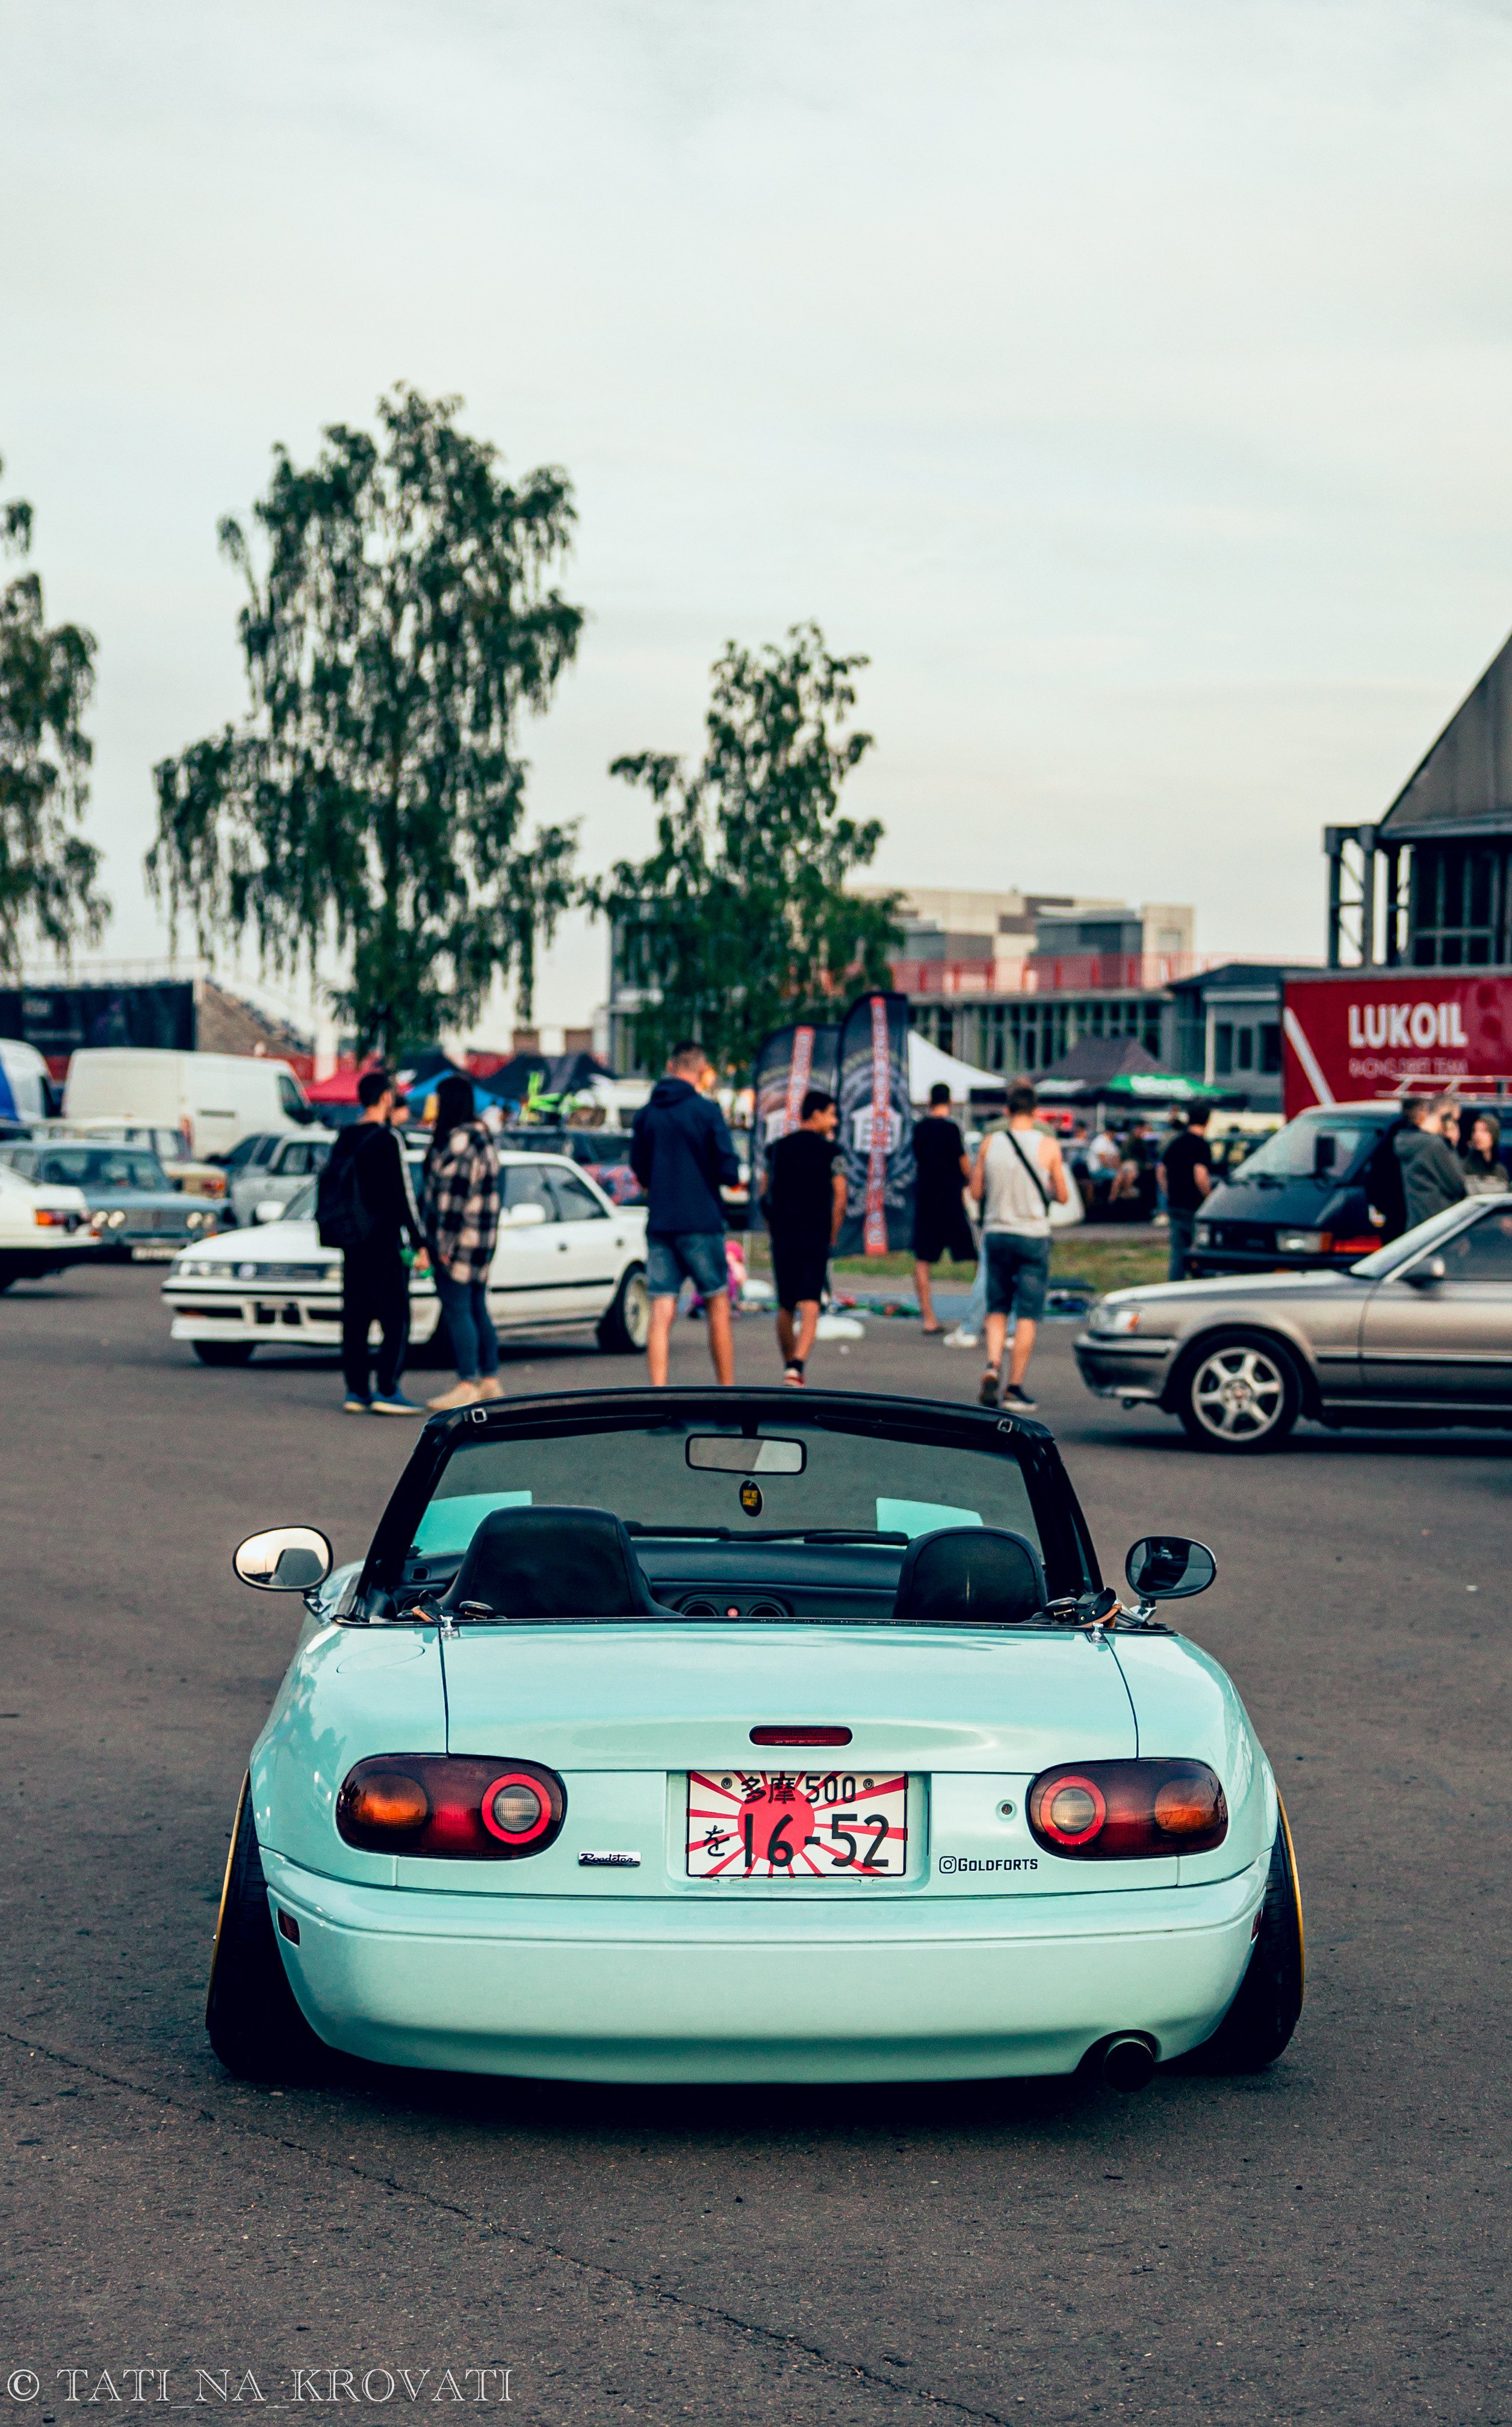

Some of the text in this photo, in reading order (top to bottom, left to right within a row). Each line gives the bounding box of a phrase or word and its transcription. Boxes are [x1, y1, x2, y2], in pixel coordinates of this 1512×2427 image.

[1348, 1003, 1468, 1049] LUKOIL
[741, 1776, 856, 1803] 多摩 500
[703, 1814, 889, 1867] を 16-52
[580, 1853, 640, 1865] Roadster
